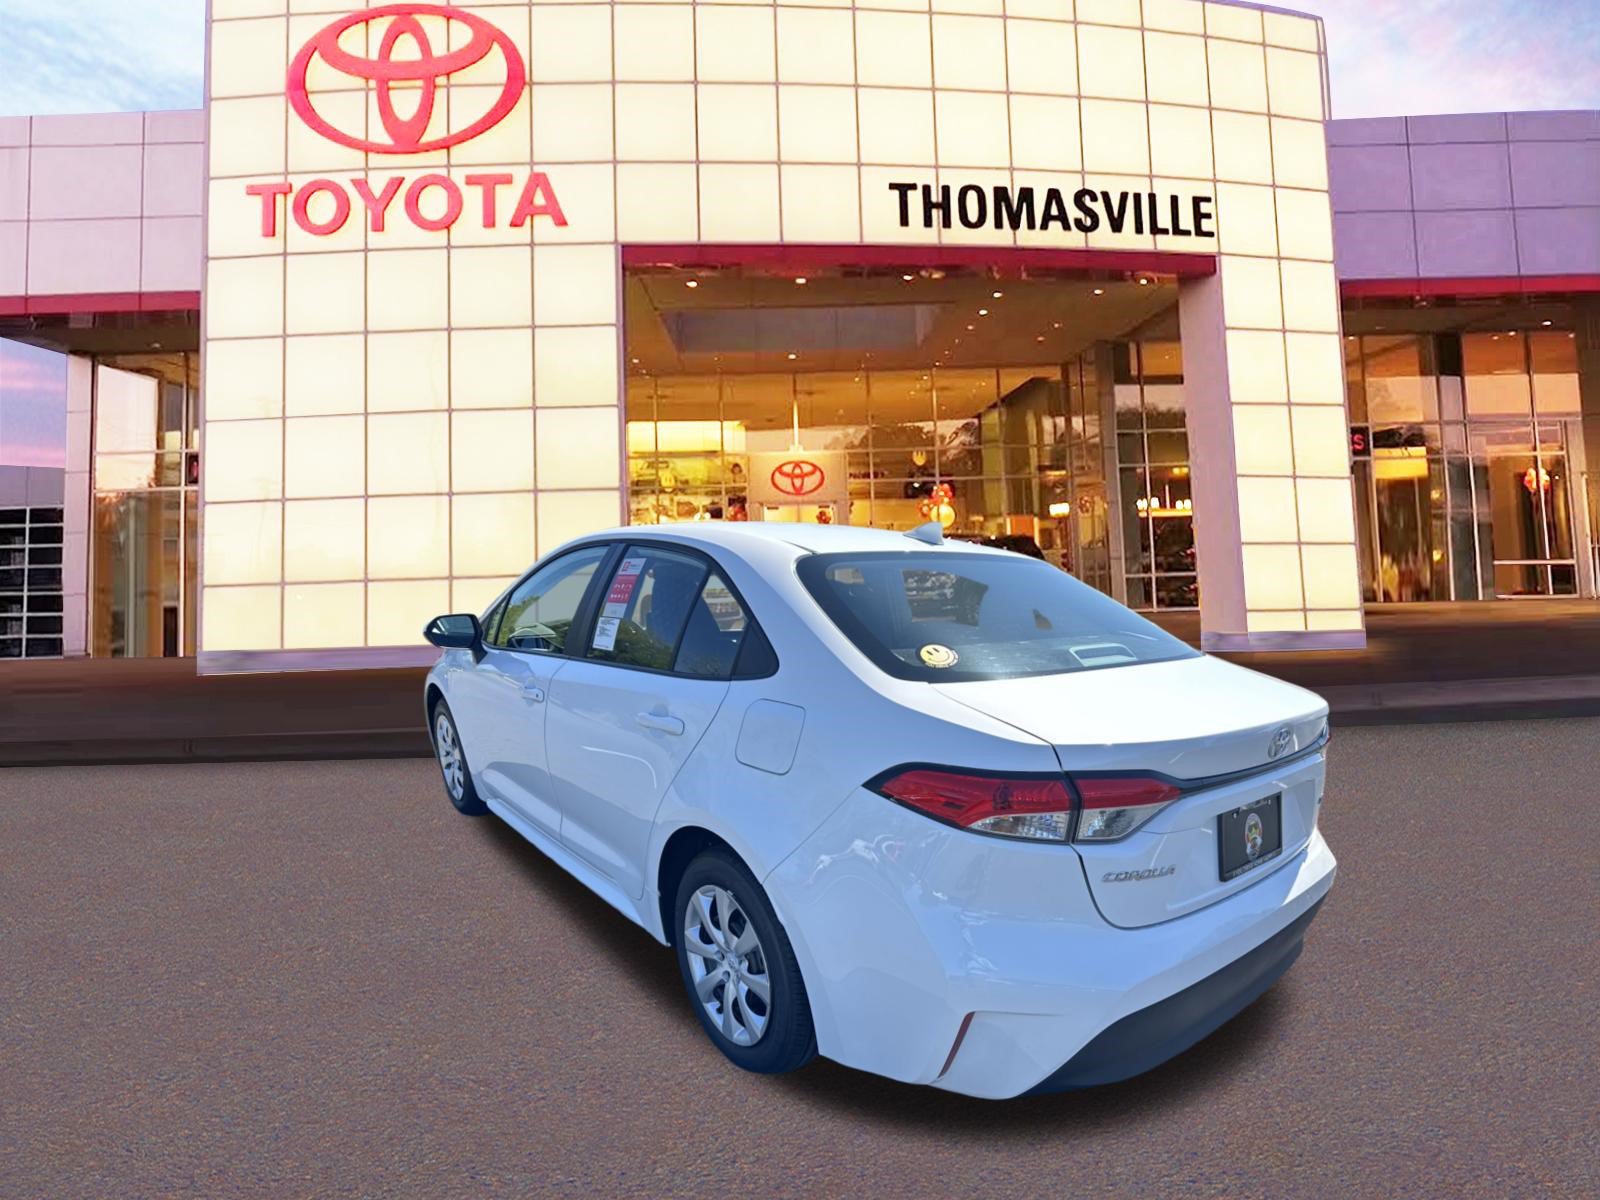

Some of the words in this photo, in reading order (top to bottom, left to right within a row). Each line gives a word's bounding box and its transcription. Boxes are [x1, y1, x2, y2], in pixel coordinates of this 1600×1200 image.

[246, 172, 568, 237] TOYOTA
[888, 182, 1215, 238] THOMASVILLE
[1103, 864, 1176, 883] COROLLA
